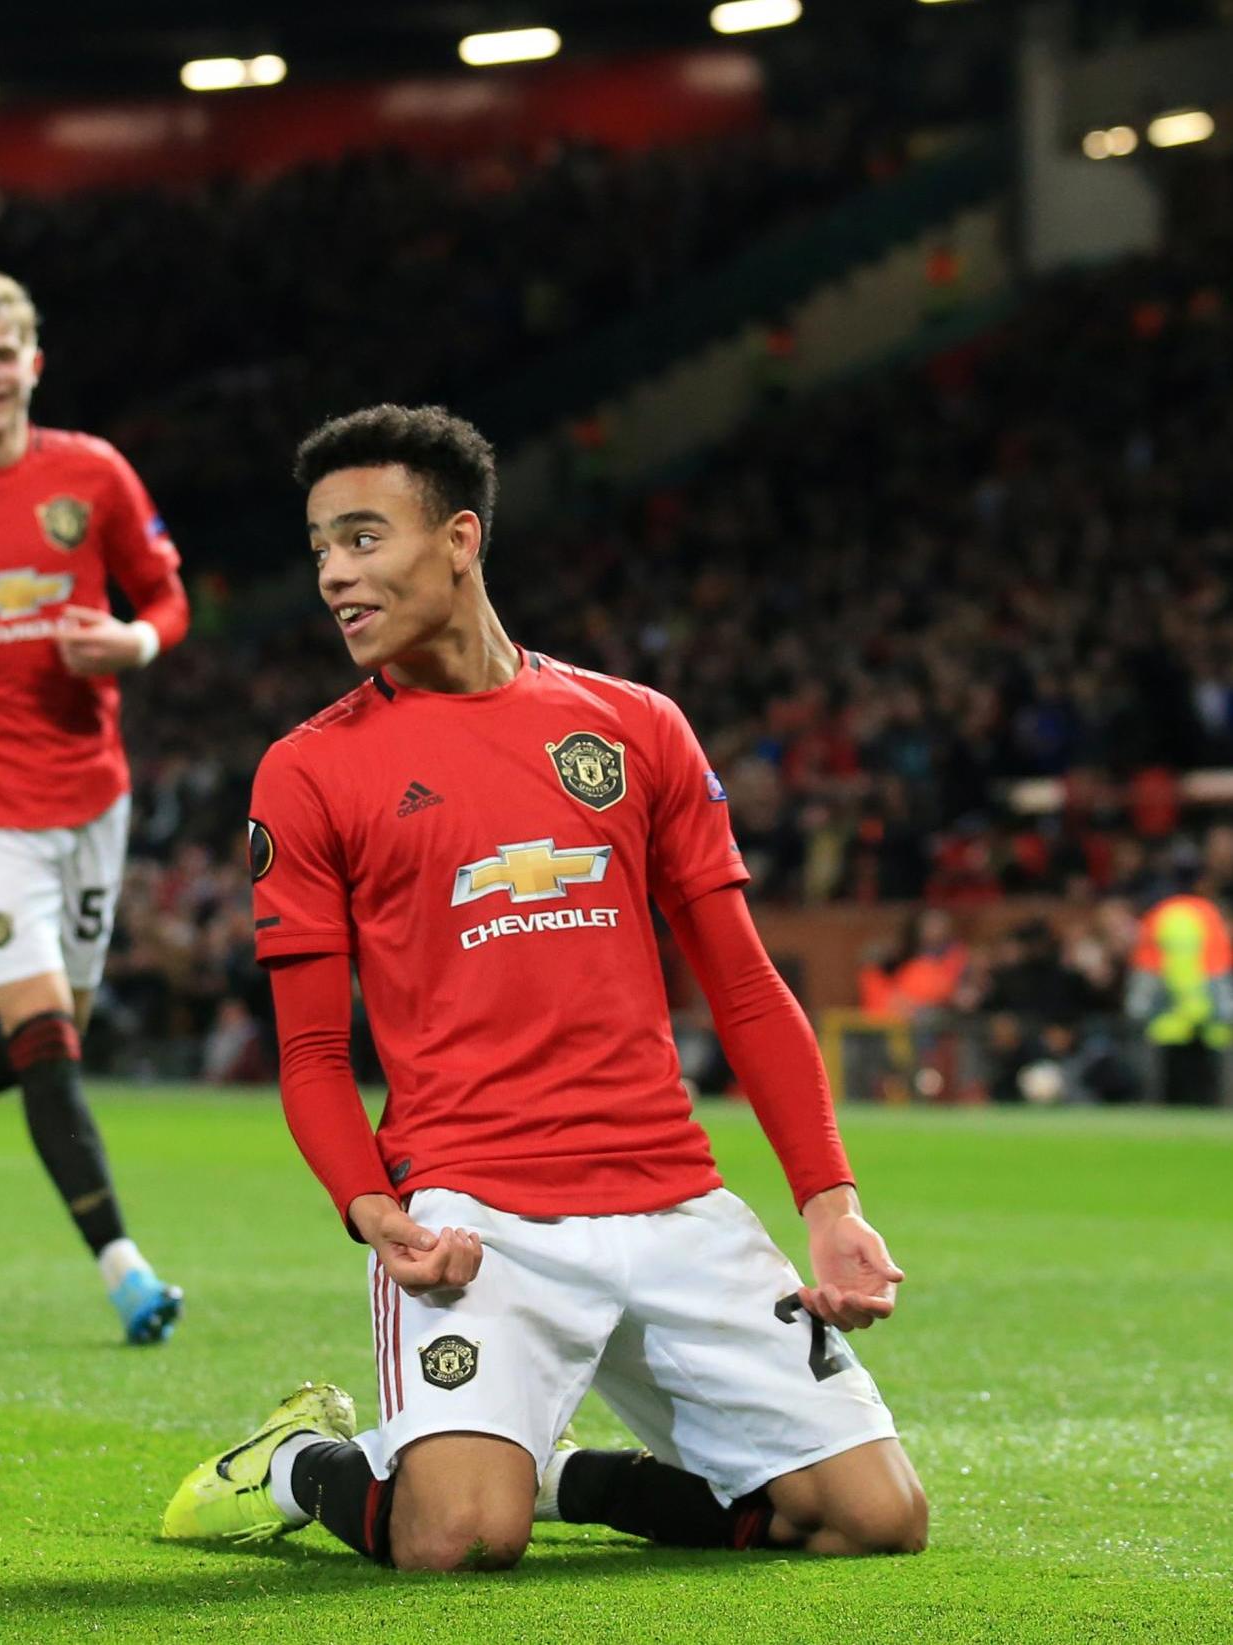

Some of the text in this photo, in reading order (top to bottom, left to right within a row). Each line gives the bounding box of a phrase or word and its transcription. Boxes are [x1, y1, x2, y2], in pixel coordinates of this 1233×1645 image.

[397, 795, 445, 818] adidas
[578, 782, 610, 794] UNITED
[75, 888, 106, 942] 5
[460, 908, 619, 950] CHEVROLET
[774, 1292, 854, 1383] 2
